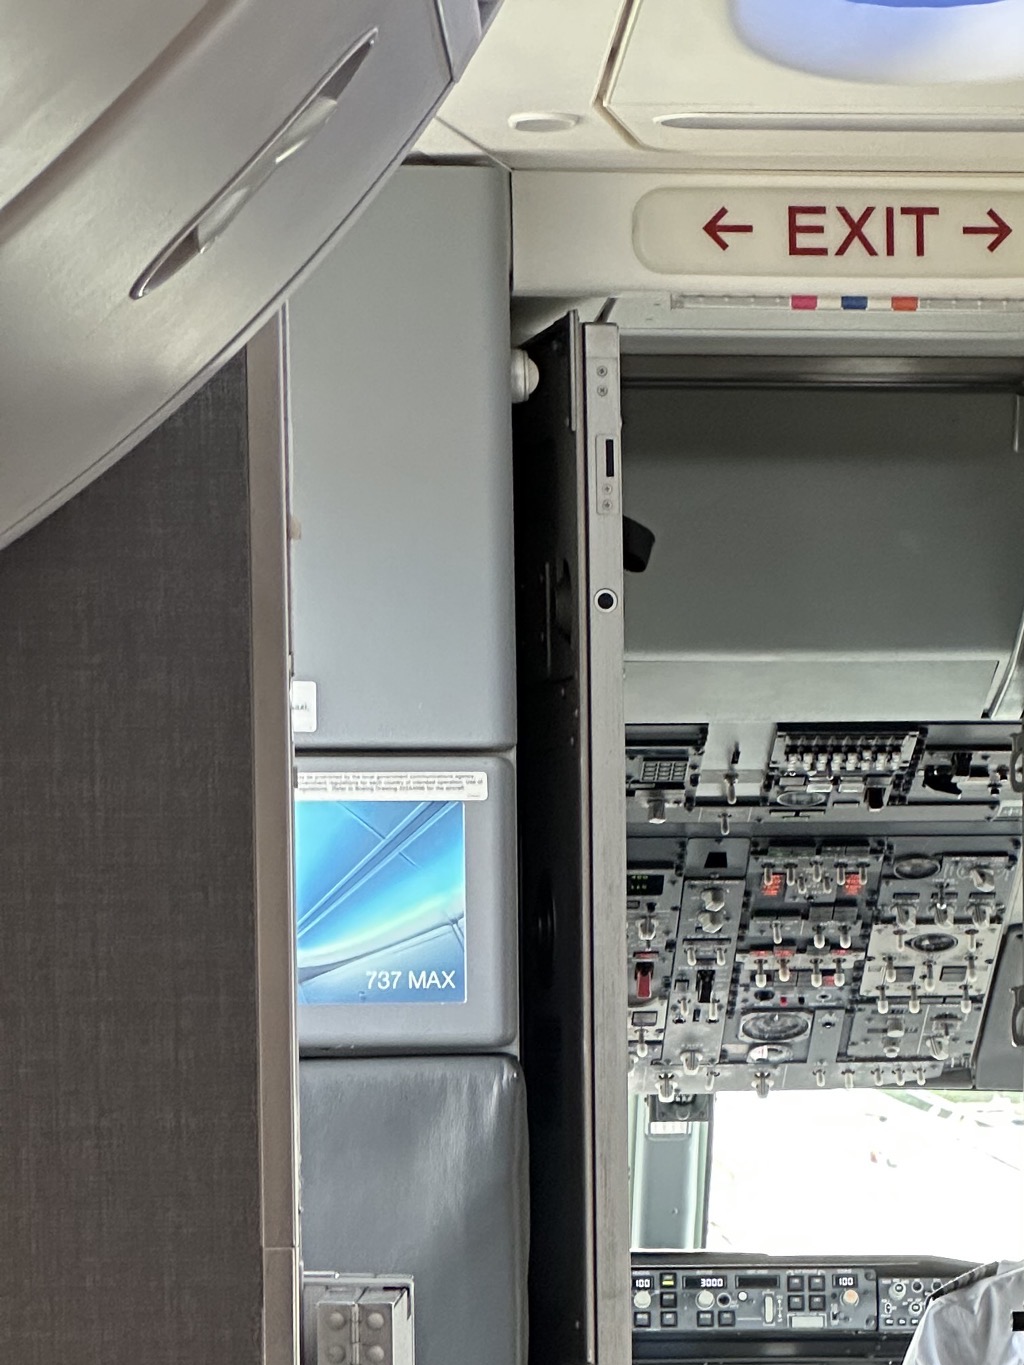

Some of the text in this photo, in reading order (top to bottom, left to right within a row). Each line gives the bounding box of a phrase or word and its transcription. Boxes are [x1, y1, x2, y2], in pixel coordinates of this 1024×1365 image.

[788, 206, 939, 256] EXIT
[366, 970, 456, 990] 737 MAX
[635, 1279, 650, 1288] 100
[700, 1278, 723, 1288] 3000
[838, 1277, 854, 1286] 100
